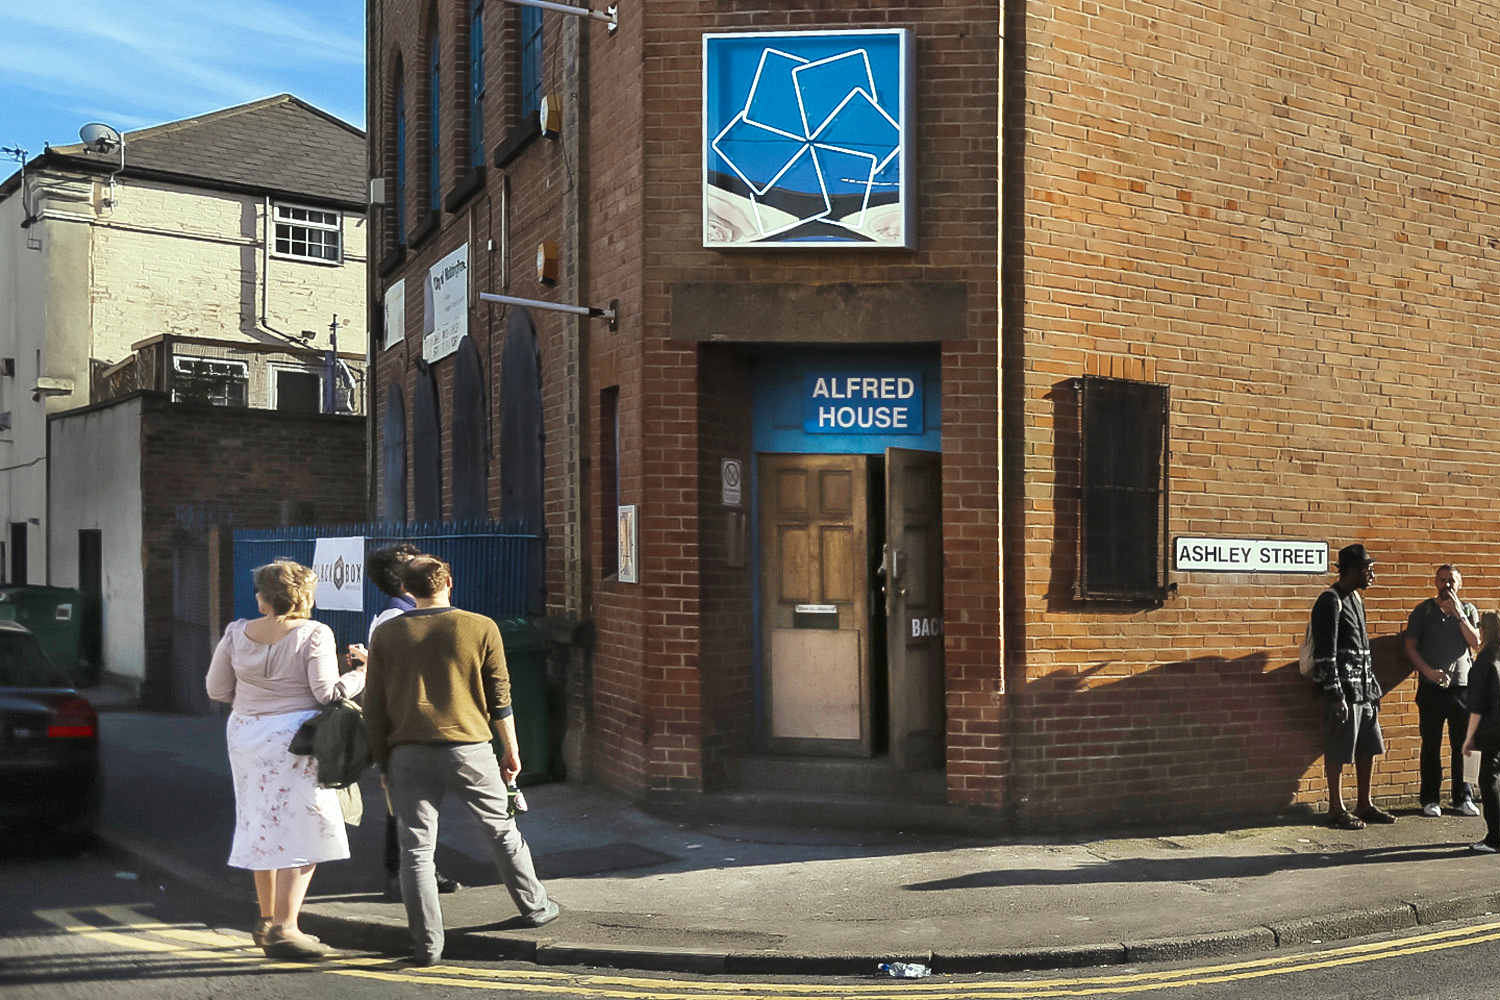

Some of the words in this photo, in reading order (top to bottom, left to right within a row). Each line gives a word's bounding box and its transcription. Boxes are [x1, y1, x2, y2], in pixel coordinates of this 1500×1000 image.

[812, 377, 915, 399] ALFRED
[818, 406, 908, 428] HOUSE
[1179, 545, 1252, 563] ASHLEY
[1259, 547, 1326, 565] STREET
[345, 563, 362, 583] BOX
[911, 618, 945, 637] BAC
